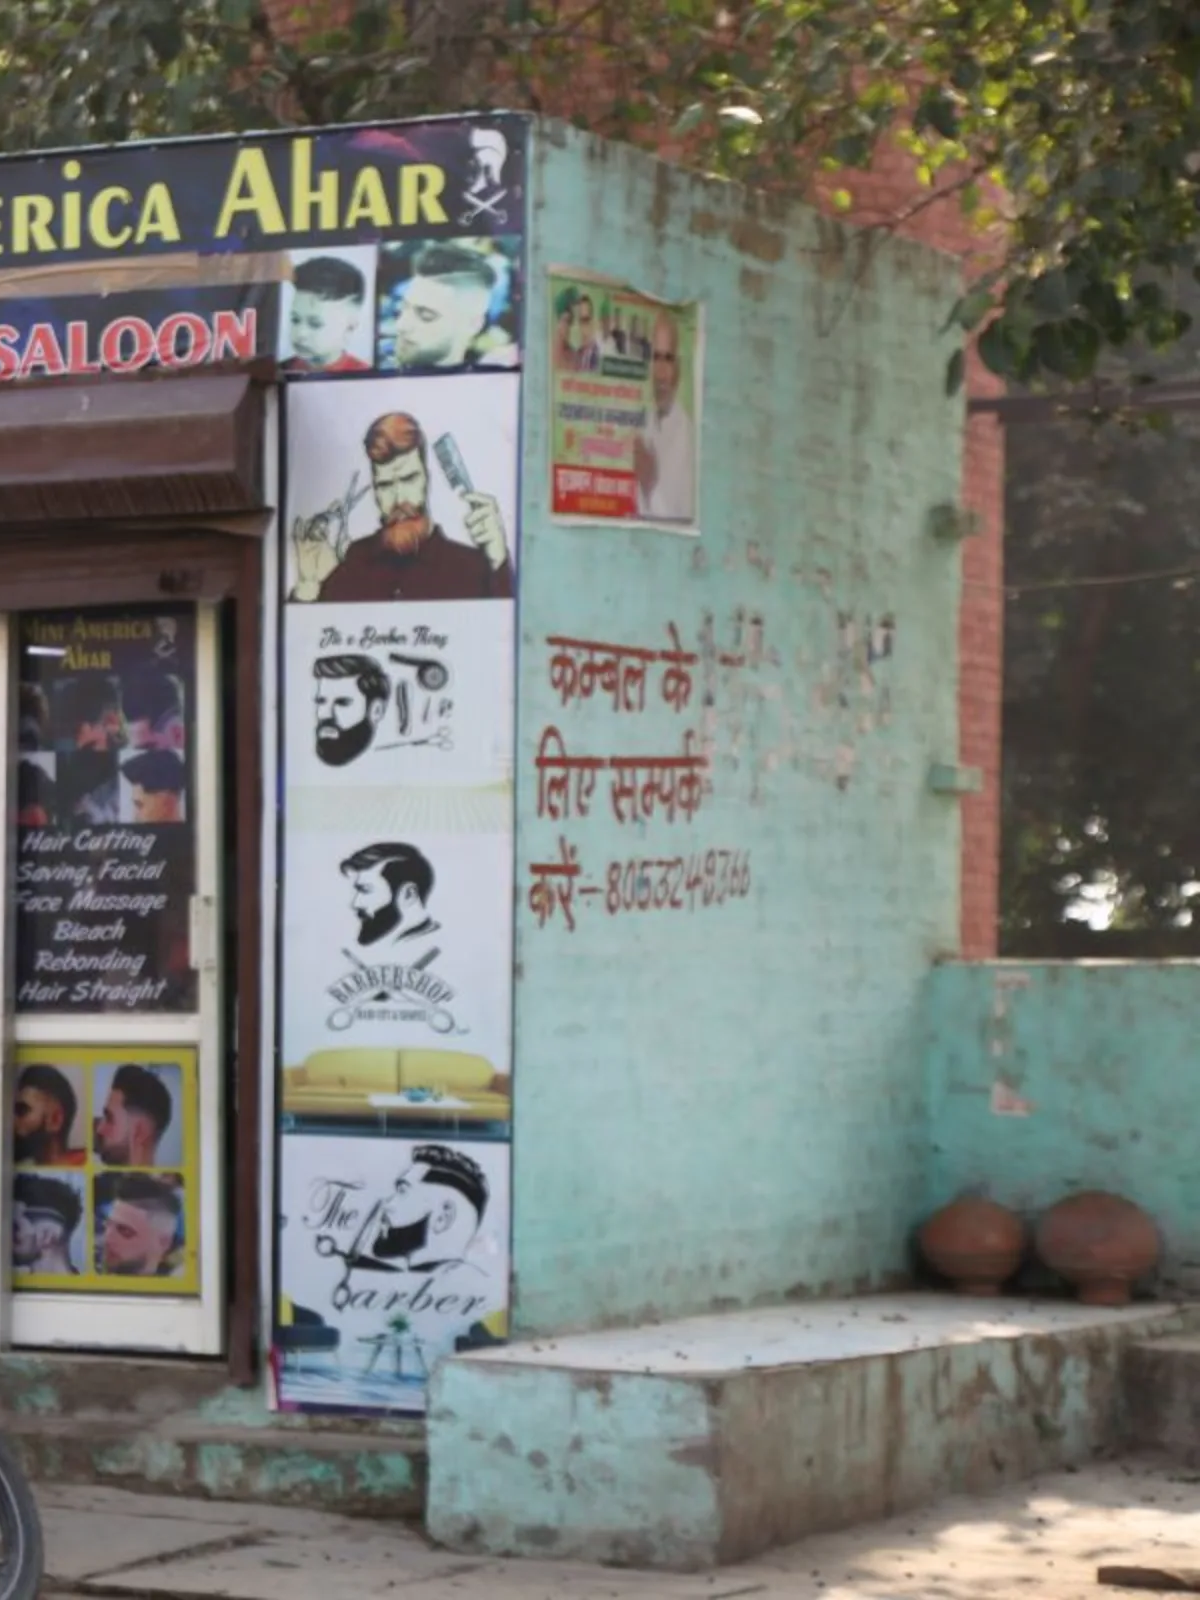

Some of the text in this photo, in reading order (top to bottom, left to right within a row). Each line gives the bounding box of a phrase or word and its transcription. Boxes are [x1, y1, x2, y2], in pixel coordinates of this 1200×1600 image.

[659, 621, 698, 713] के
[535, 724, 606, 821] लिए
[22, 829, 156, 857] Hair Cutting
[99, 857, 167, 881] Facial
[68, 890, 168, 917] Massage
[53, 918, 127, 941] Bleach
[34, 948, 147, 976] Rebonding
[18, 978, 168, 1007] Hair Straight
[307, 1176, 366, 1230] The
